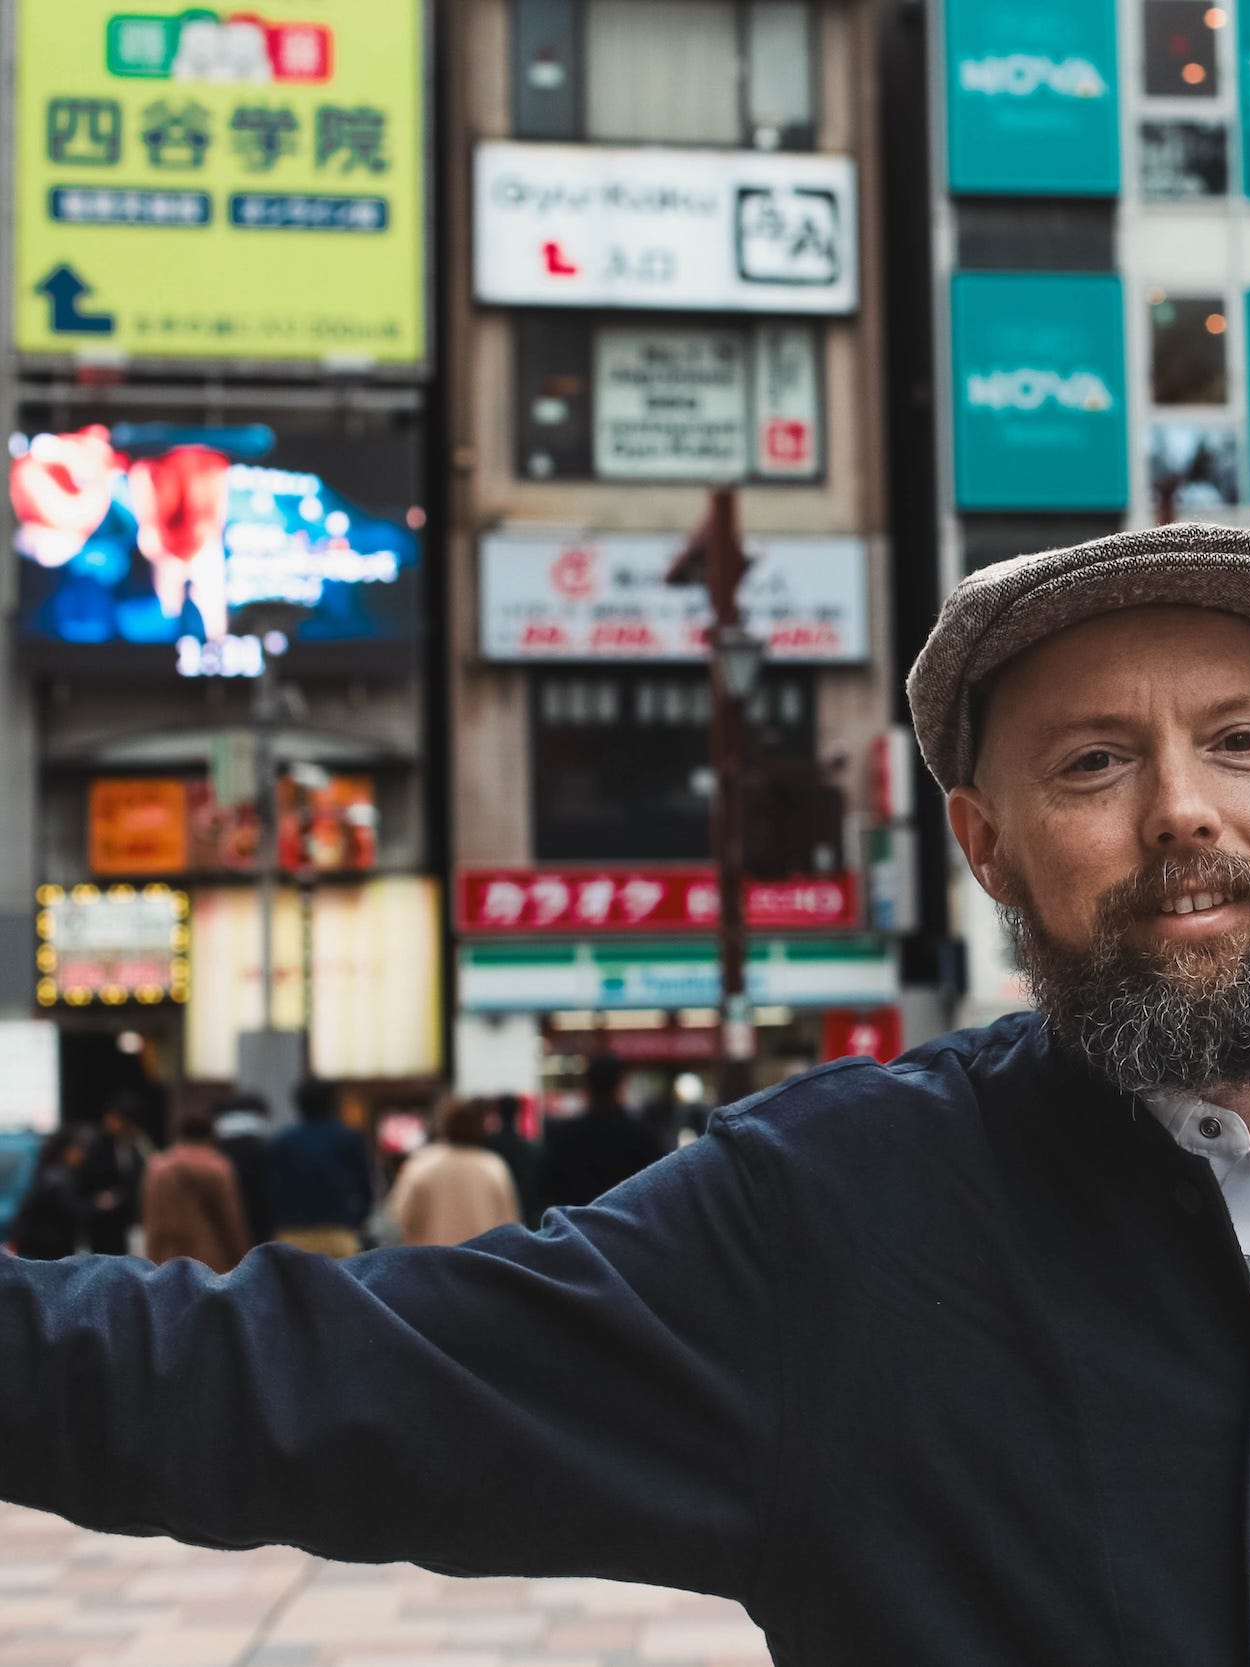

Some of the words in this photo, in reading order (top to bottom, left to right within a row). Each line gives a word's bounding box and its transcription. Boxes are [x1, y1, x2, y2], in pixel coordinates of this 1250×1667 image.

[959, 54, 1107, 97] NOVA
[47, 97, 390, 173] 四谷学院
[965, 368, 1112, 410] NOVA
[482, 877, 664, 922] カラオケ
